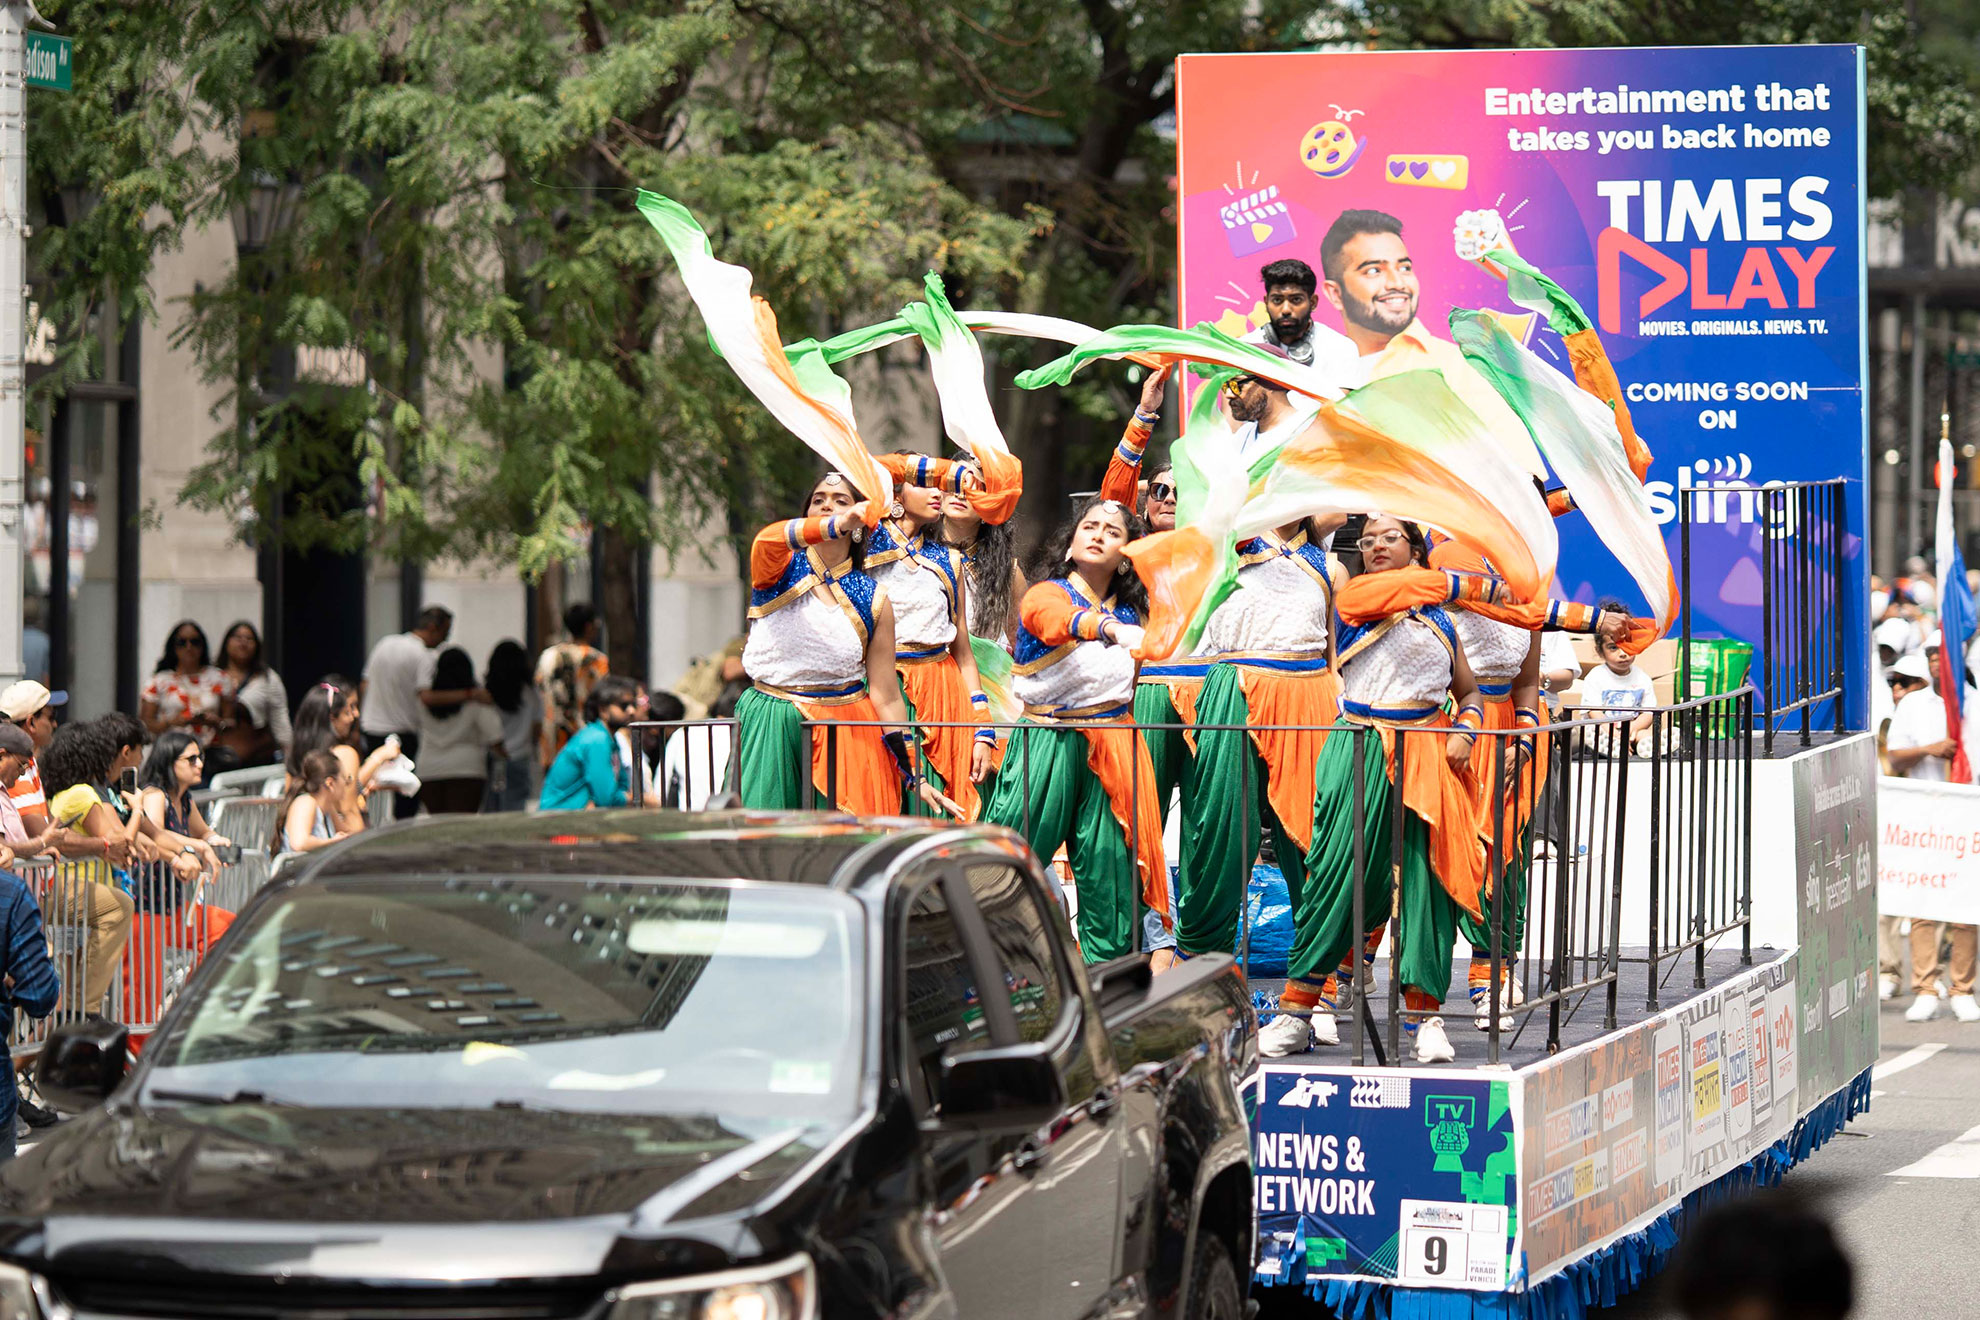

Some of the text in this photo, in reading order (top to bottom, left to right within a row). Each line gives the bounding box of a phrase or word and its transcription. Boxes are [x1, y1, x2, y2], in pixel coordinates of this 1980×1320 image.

[1485, 82, 1831, 115] Entertainment that
[1507, 123, 1831, 154] takes you back home
[1597, 175, 1833, 242] TIMES
[1639, 319, 1829, 336] MOVIES. ORIGINALS. NEWS. TV.
[1626, 381, 1808, 402] COMING SOON
[1698, 409, 1737, 430] ON
[1643, 457, 1800, 540] sling
[1884, 822, 1966, 859] Marching
[1658, 1048, 1680, 1090] TIMES
[1730, 1053, 1747, 1086] NOW
[1435, 1103, 1465, 1120] TV
[1658, 1084, 1681, 1127] NOW
[1258, 1132, 1366, 1172] NEWS &
[1423, 1235, 1448, 1276] 9
